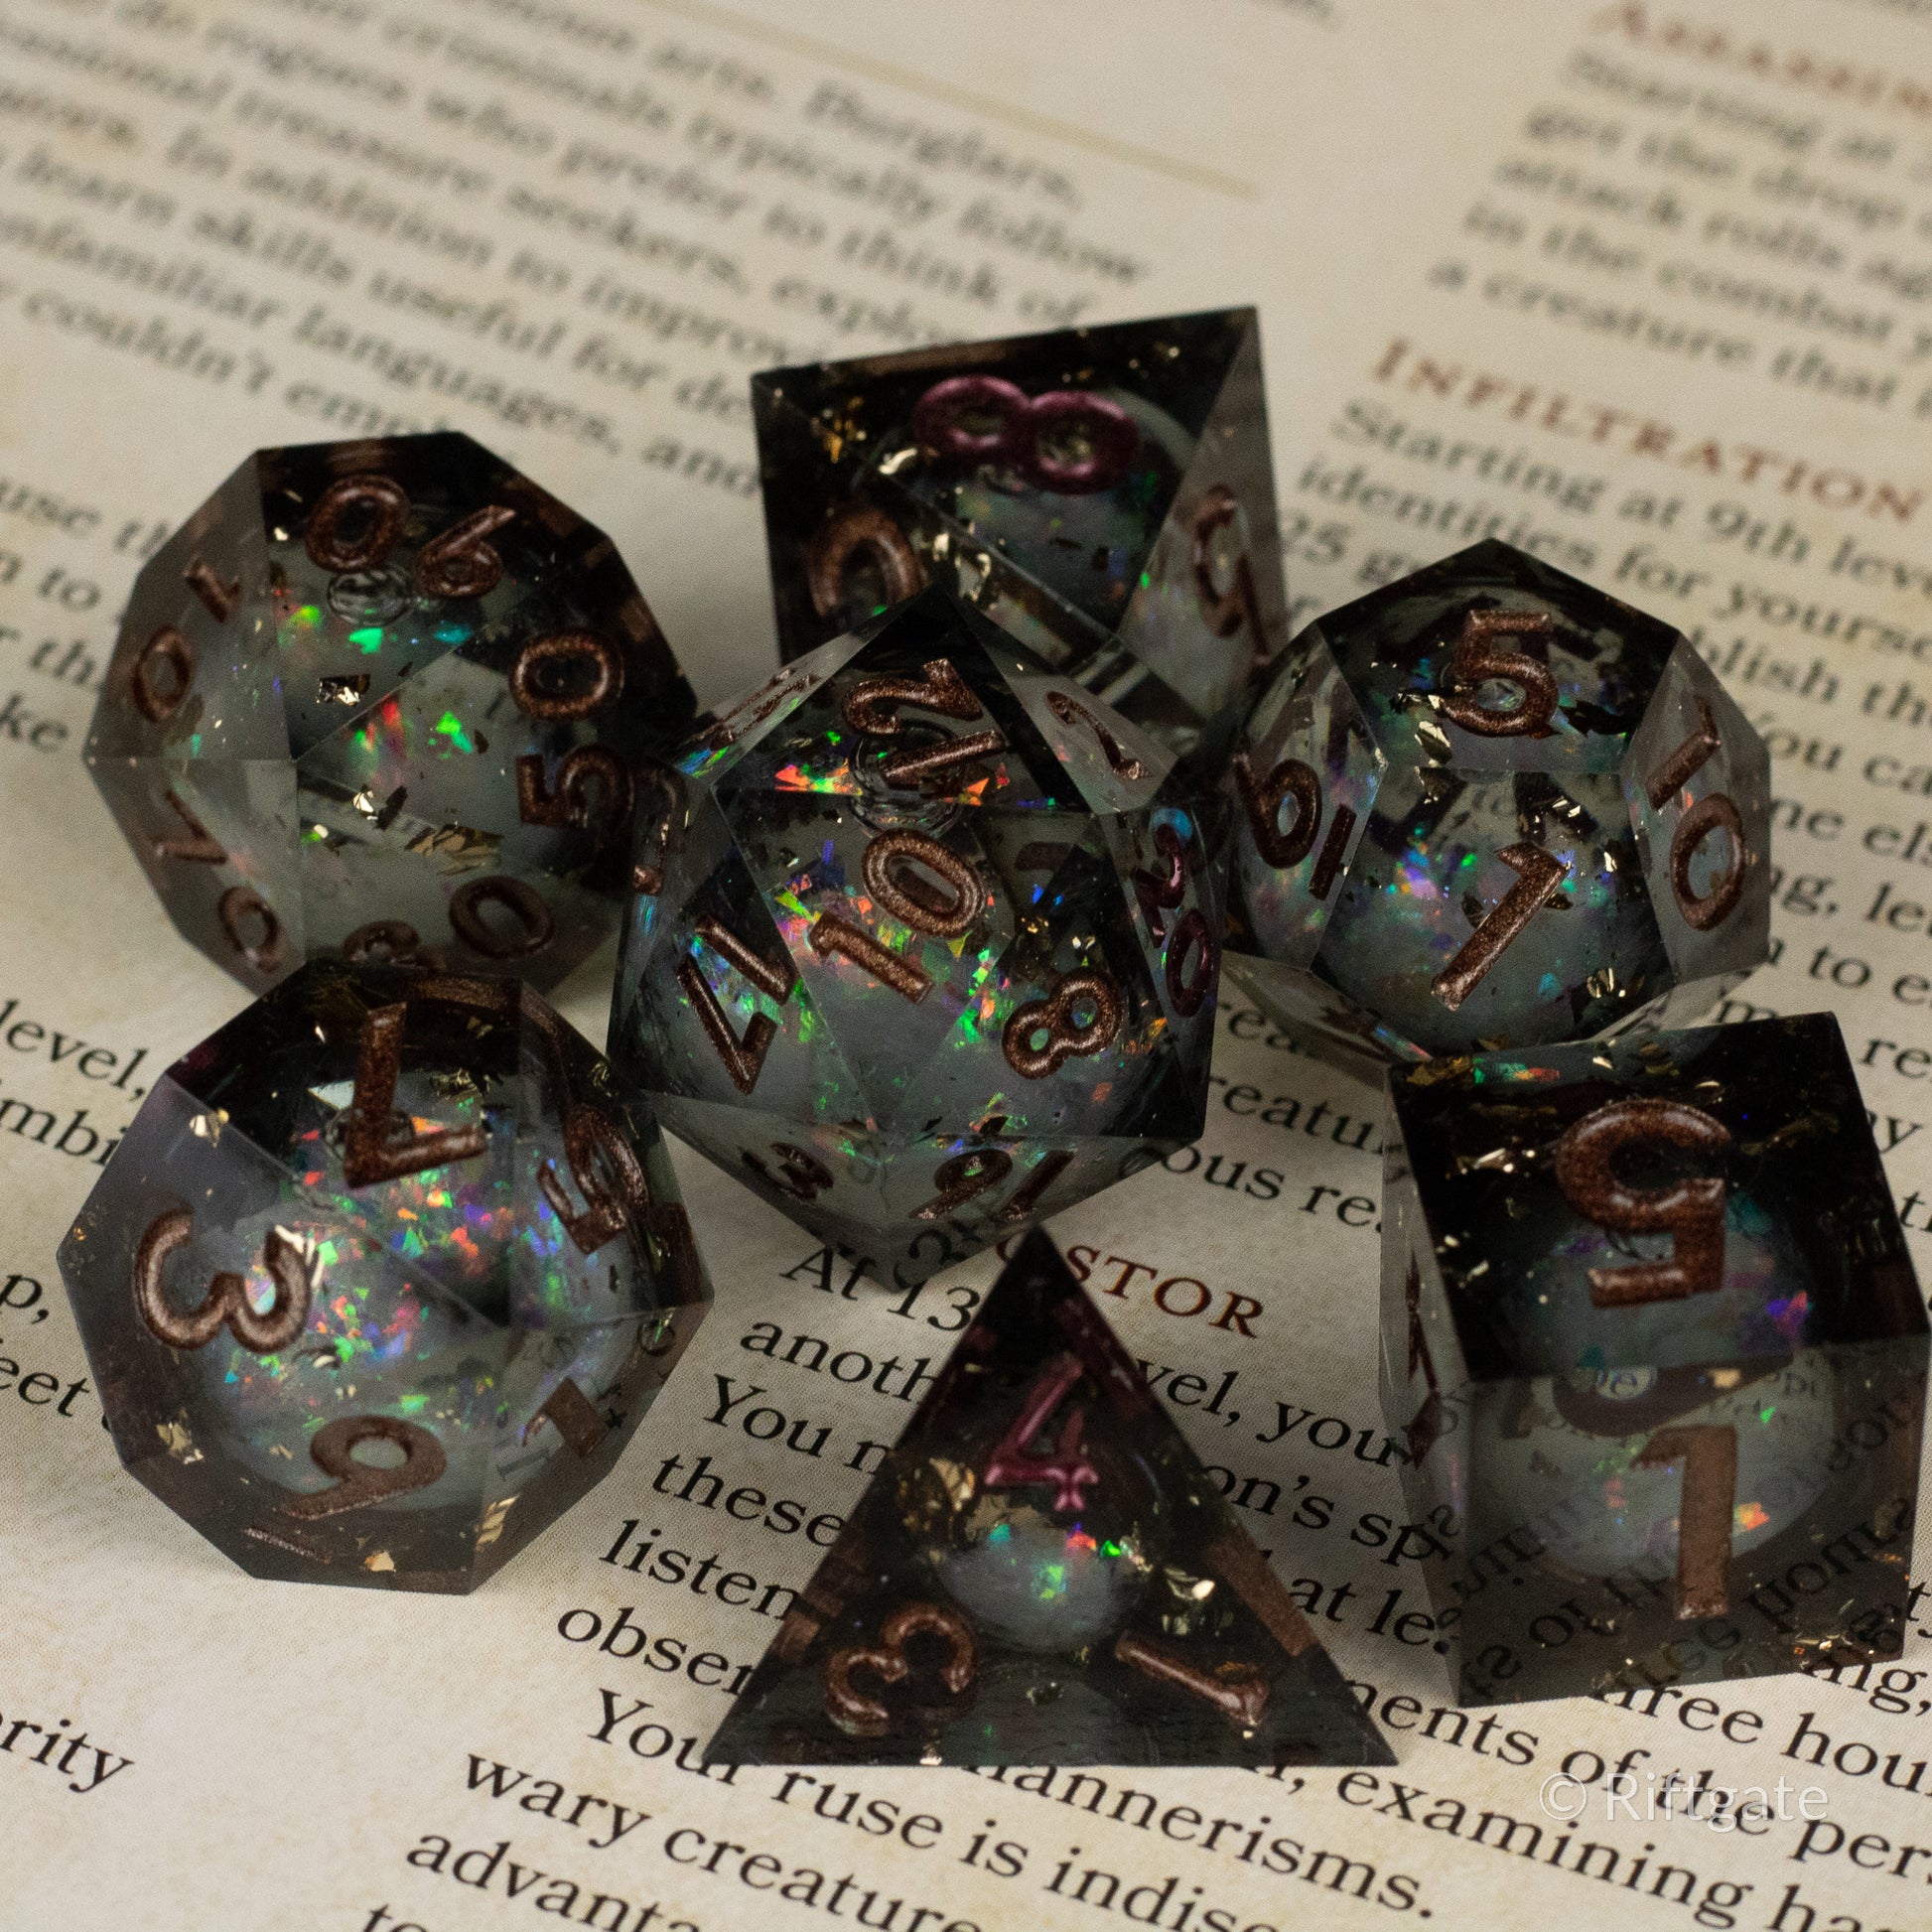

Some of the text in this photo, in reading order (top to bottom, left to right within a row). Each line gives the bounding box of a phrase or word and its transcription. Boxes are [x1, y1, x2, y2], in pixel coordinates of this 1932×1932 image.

[1330, 399, 1606, 514] Starting
[1617, 486, 1682, 530] at
[1706, 498, 1811, 567] 9th
[1369, 334, 1923, 524] INFILTRATION
[39, 567, 100, 613] to
[1611, 543, 1715, 602] for
[1449, 608, 1560, 739] 5
[1428, 840, 1571, 1013] 1
[1807, 941, 1873, 989] to
[1002, 966, 1124, 1081] 8
[1298, 1183, 1382, 1233] re
[1552, 1097, 1733, 1310] 5
[996, 1234, 1266, 1338] STOR
[701, 1372, 835, 1458] You
[983, 1350, 1101, 1513] 4
[651, 1449, 848, 1549] these
[1626, 1423, 1740, 1622] 1
[598, 1519, 804, 1622] listen
[0, 1717, 135, 1794] rity
[467, 1752, 652, 1849] wary
[770, 1770, 944, 1852] ruse
[959, 1819, 1032, 1878] is
[1042, 1846, 1281, 1932] indis
[1337, 1769, 1754, 1931] examining
[1560, 1747, 1652, 1795] of
[1656, 1767, 1776, 1837] the
[1788, 1816, 1932, 1886] per
